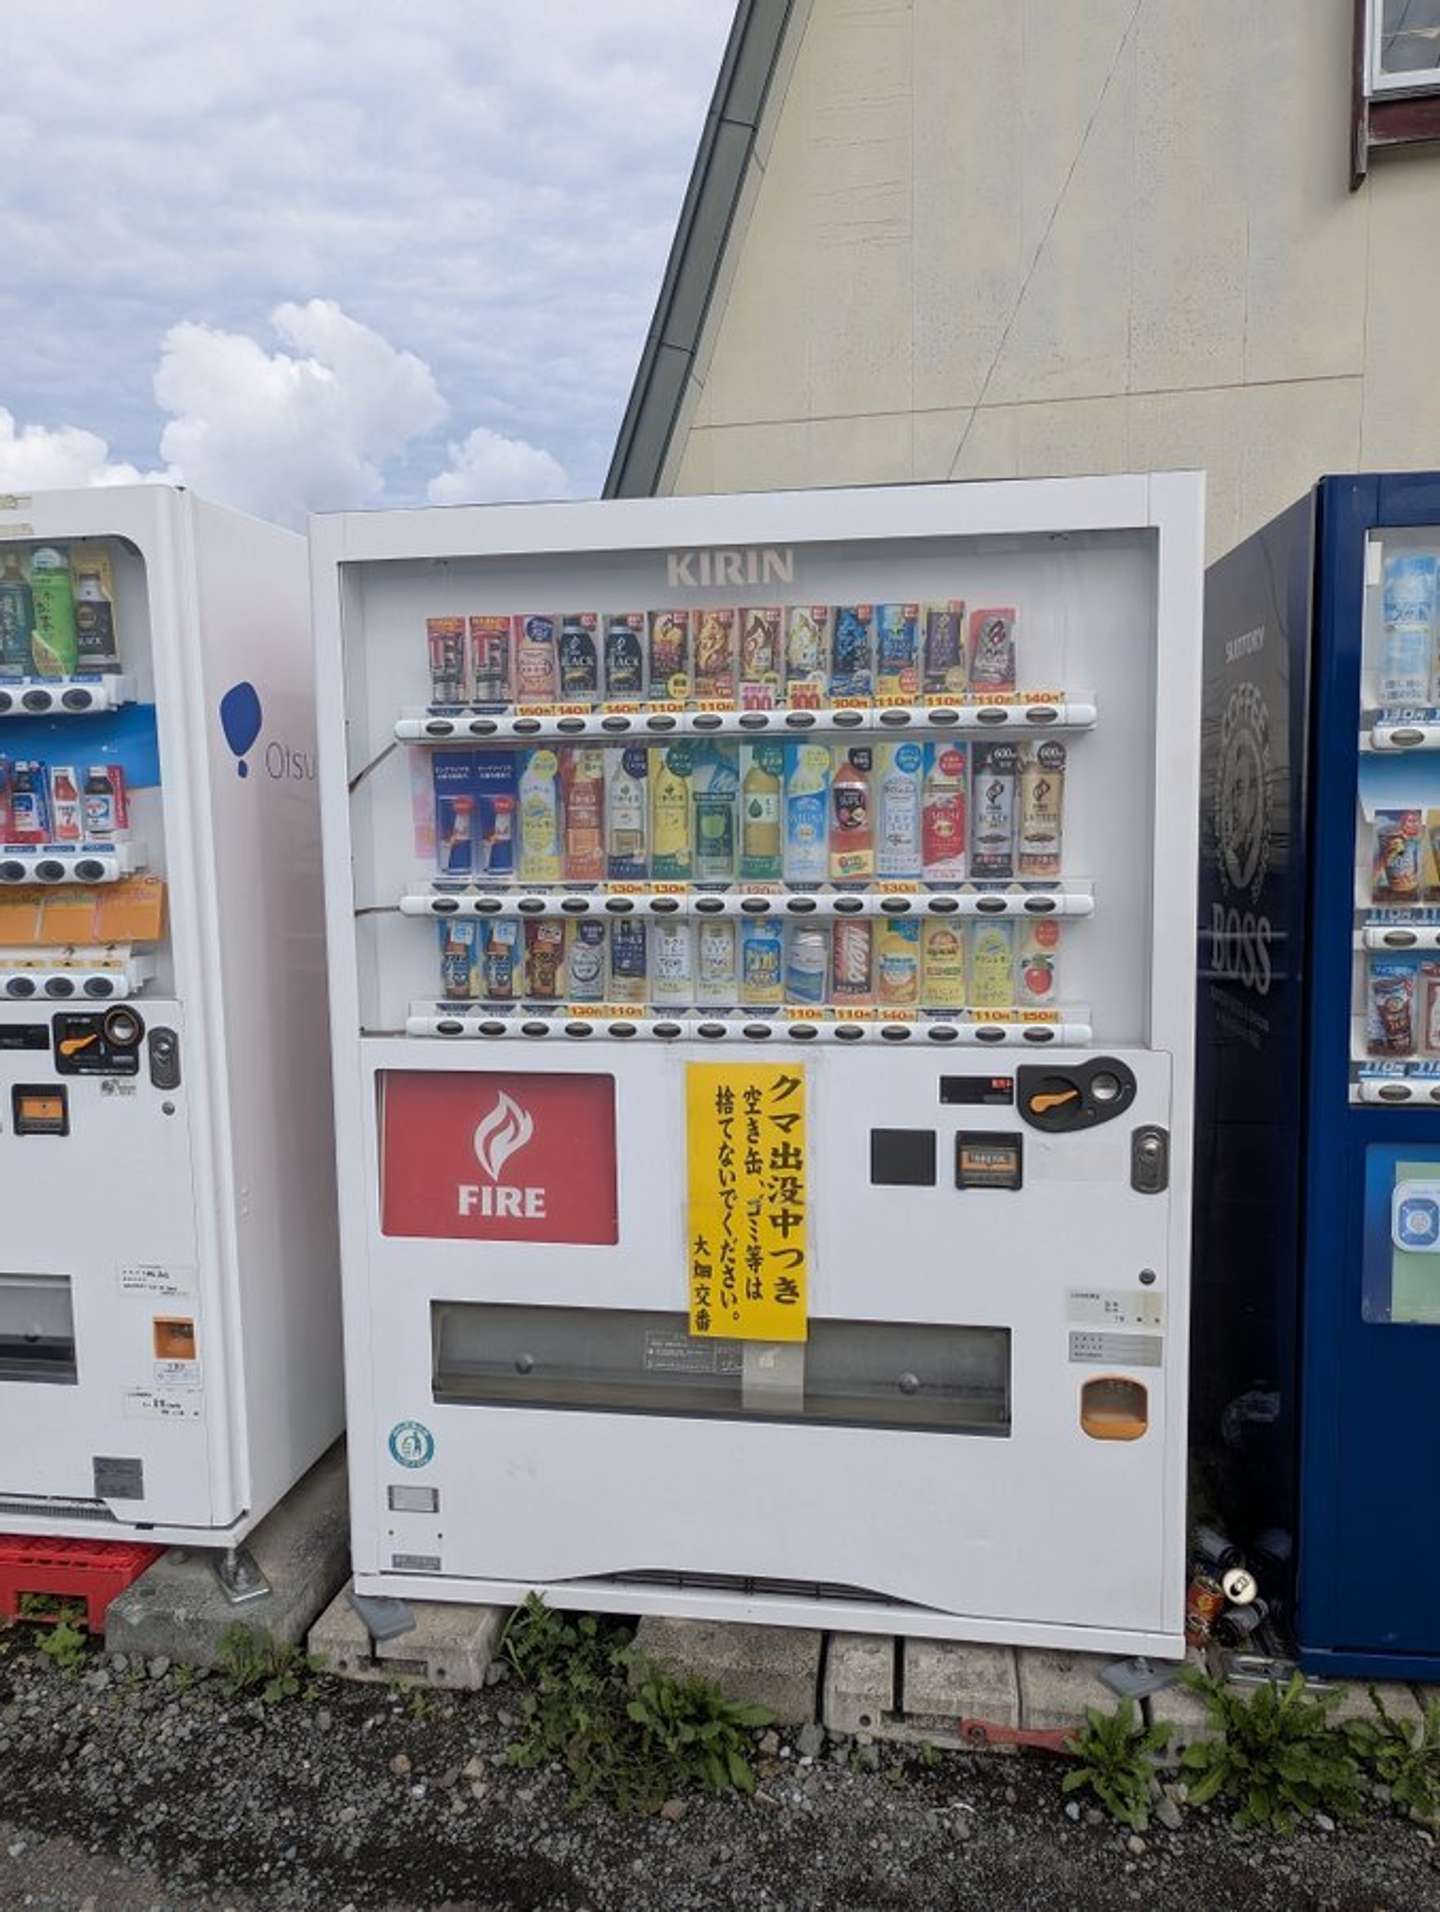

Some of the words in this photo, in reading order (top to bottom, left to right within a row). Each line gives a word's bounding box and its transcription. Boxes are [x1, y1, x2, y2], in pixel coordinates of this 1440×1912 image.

[667, 549, 793, 587] KIRIN
[1211, 902, 1271, 996] BOSS
[458, 1184, 546, 1218] FIRE
[715, 1085, 740, 1321] 捨てないでください。
[743, 1085, 764, 1300] 空き缶、ゴミ等は
[769, 1075, 804, 1304] クマ出没中つき
[693, 1234, 712, 1332] 大畑交番
